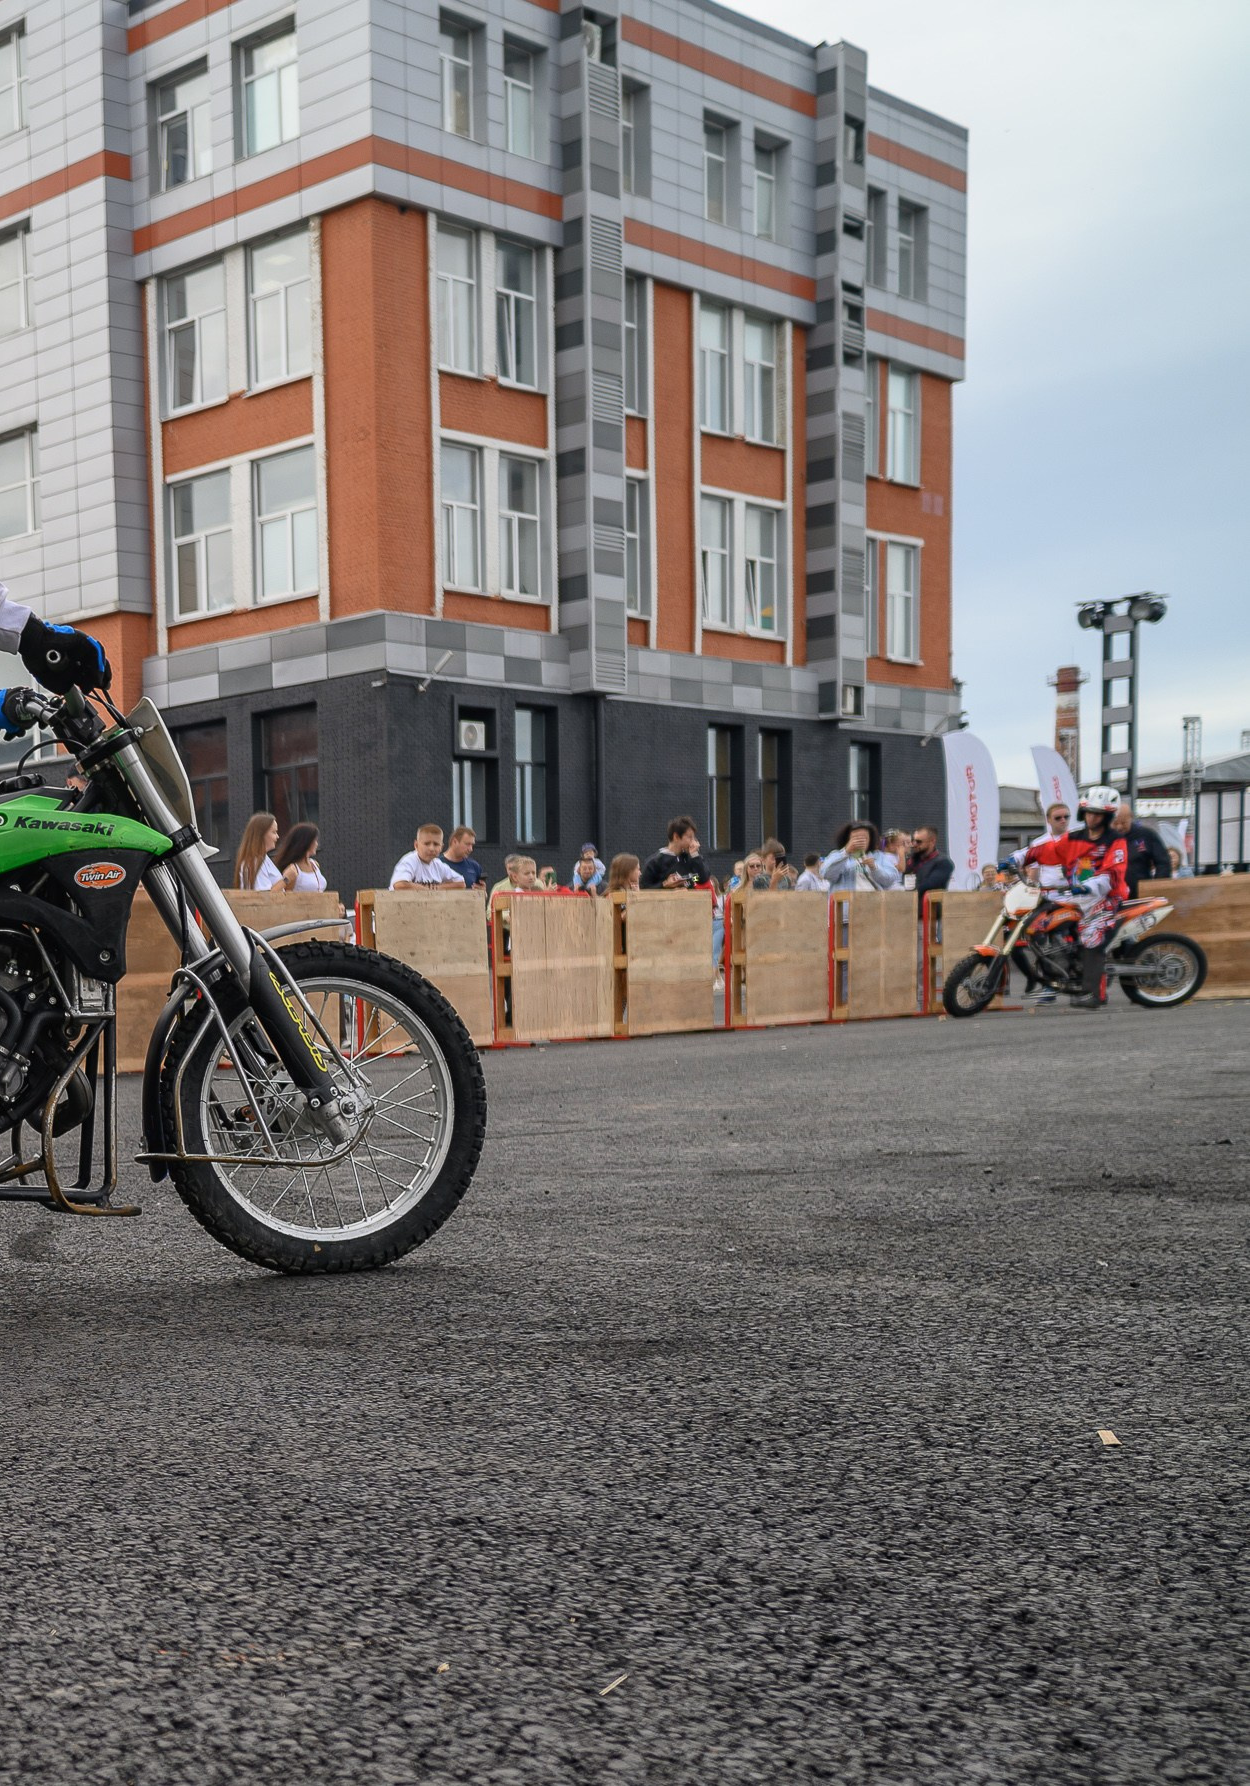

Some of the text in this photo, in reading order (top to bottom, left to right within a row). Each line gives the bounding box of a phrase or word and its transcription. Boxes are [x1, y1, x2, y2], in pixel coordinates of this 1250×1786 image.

[964, 764, 978, 832] MOTOR
[14, 816, 115, 836] Kawasaki
[80, 870, 122, 882] Twin Air
